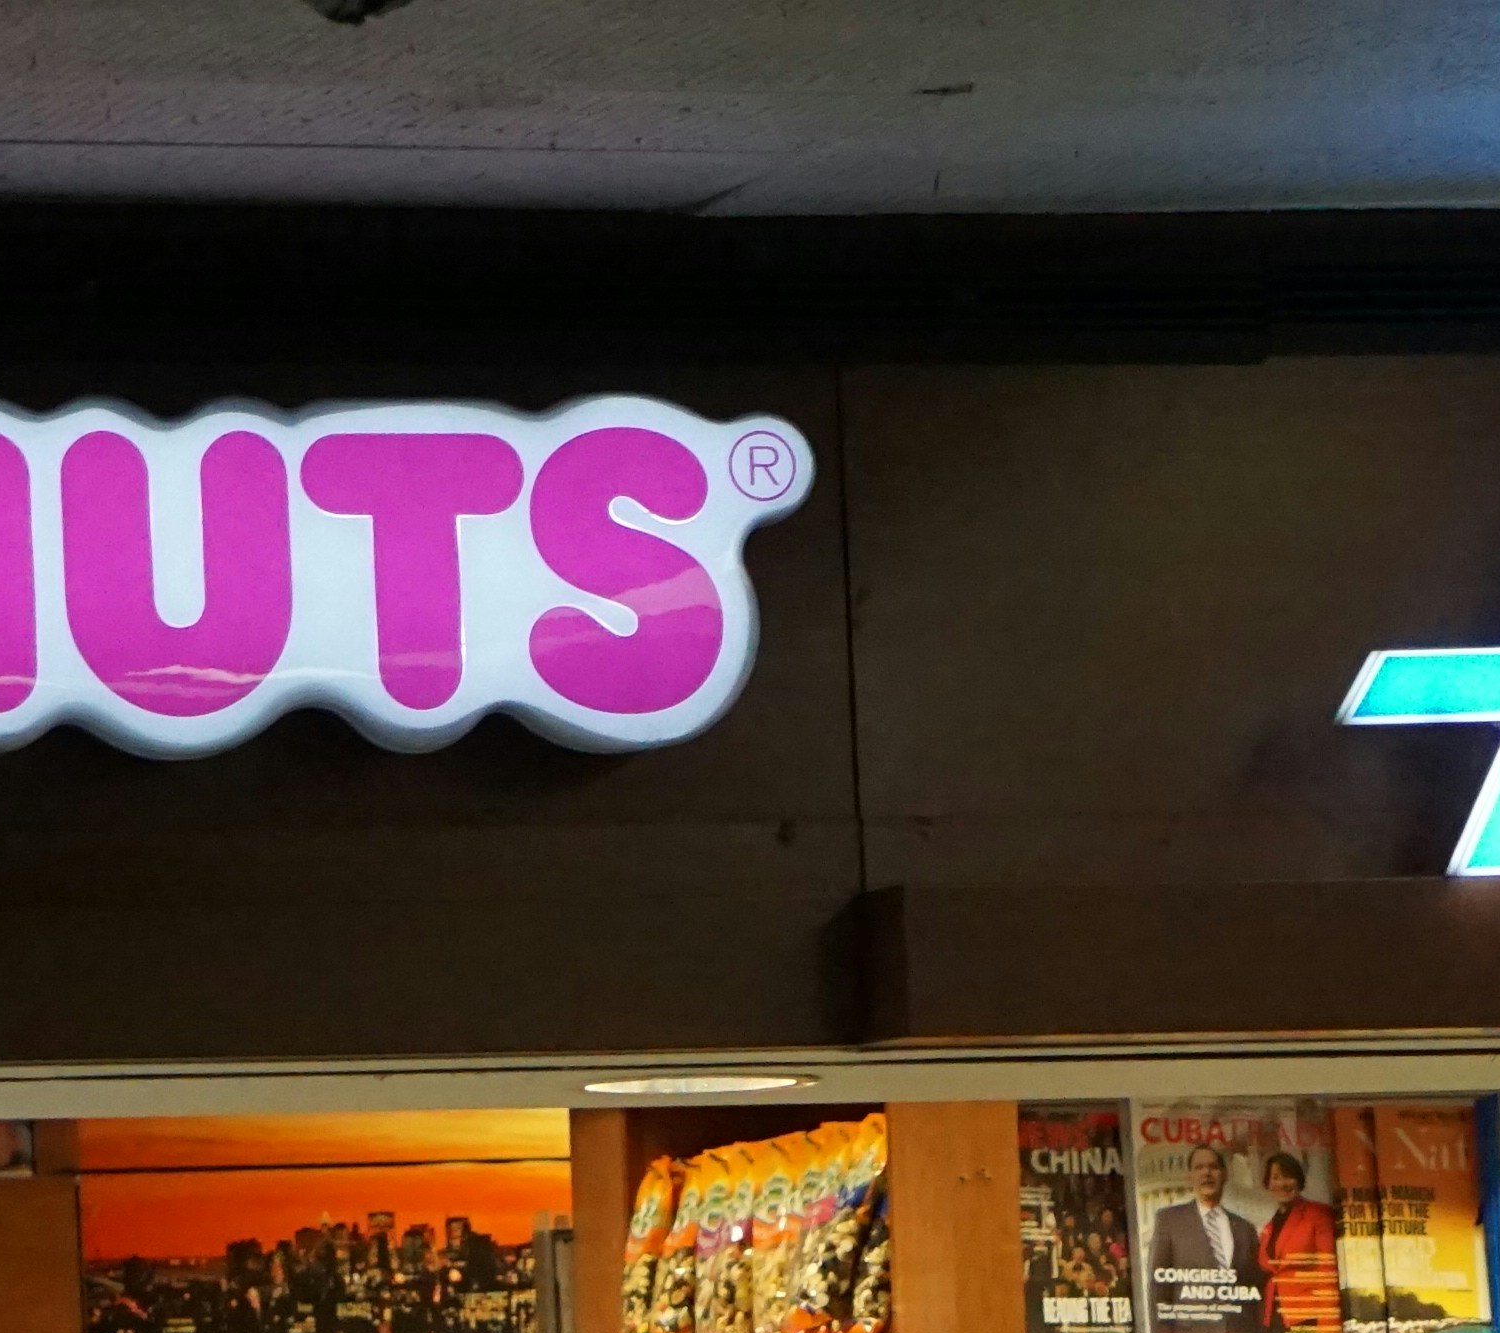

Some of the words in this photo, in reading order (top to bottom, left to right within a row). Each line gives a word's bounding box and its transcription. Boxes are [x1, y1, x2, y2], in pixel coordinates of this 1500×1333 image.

[1031, 1147, 1122, 1175] CHINA
[1154, 1268, 1237, 1284] CONGRESS
[1180, 1285, 1215, 1301] AND
[1217, 1284, 1261, 1301] CUBA
